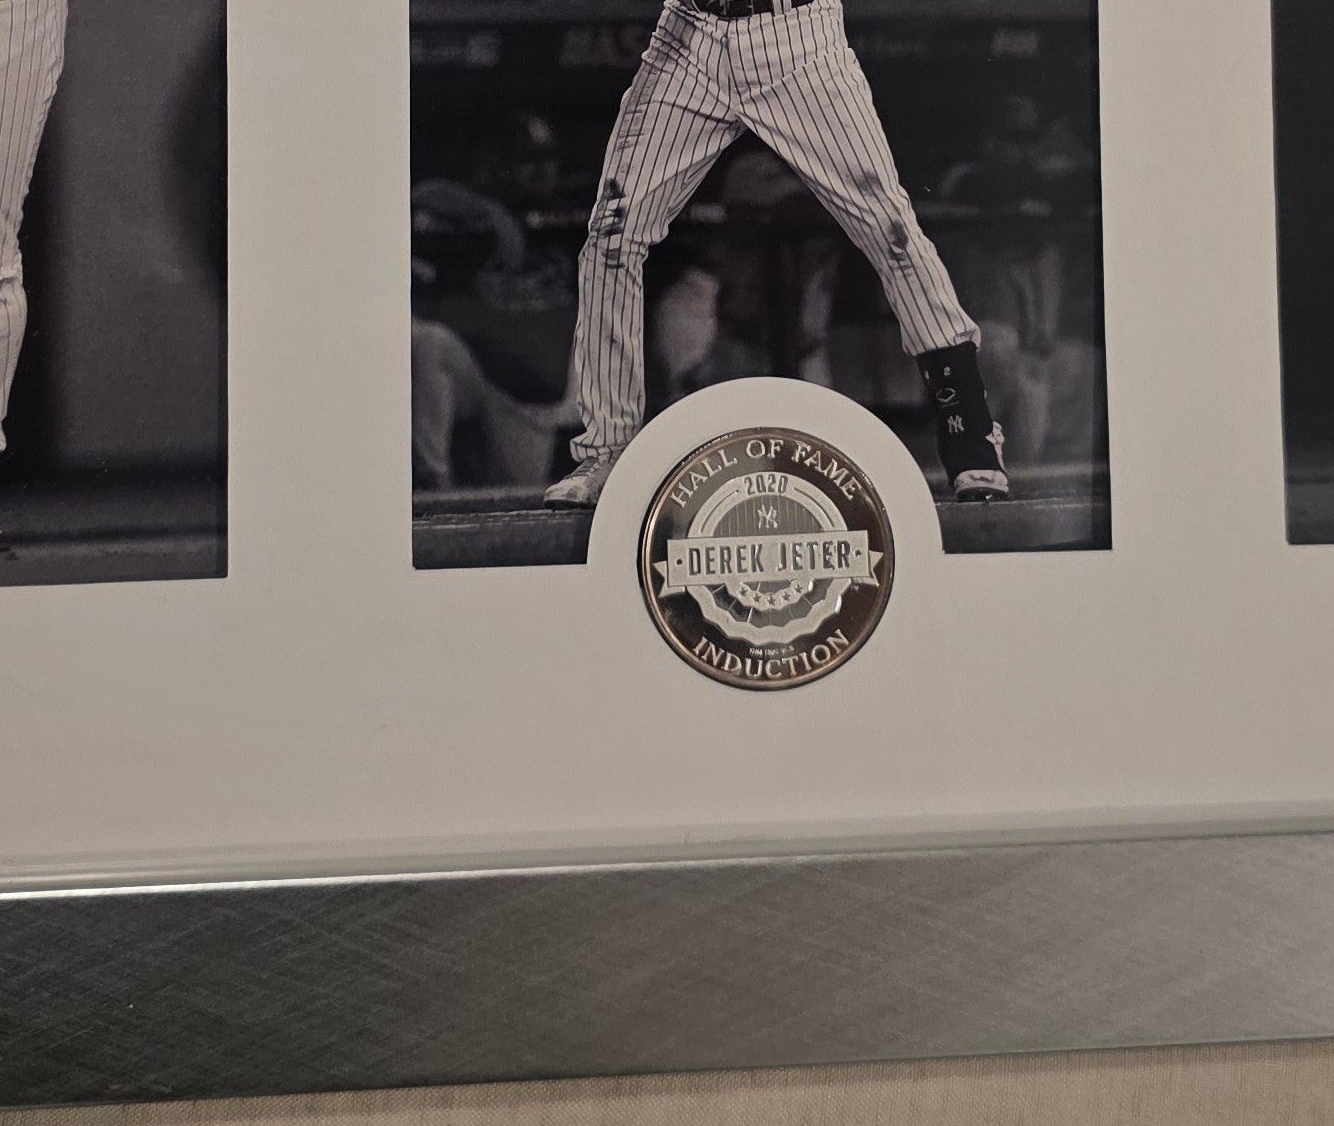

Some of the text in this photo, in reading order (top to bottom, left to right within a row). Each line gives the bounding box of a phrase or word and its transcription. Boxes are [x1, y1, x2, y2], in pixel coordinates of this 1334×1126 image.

[947, 415, 965, 433] NY
[669, 438, 863, 508] HALL OF FAME
[743, 473, 789, 496] 2020
[757, 504, 779, 530] NY
[687, 539, 853, 577] DEREK JETER
[690, 627, 851, 680] INDUCTION
